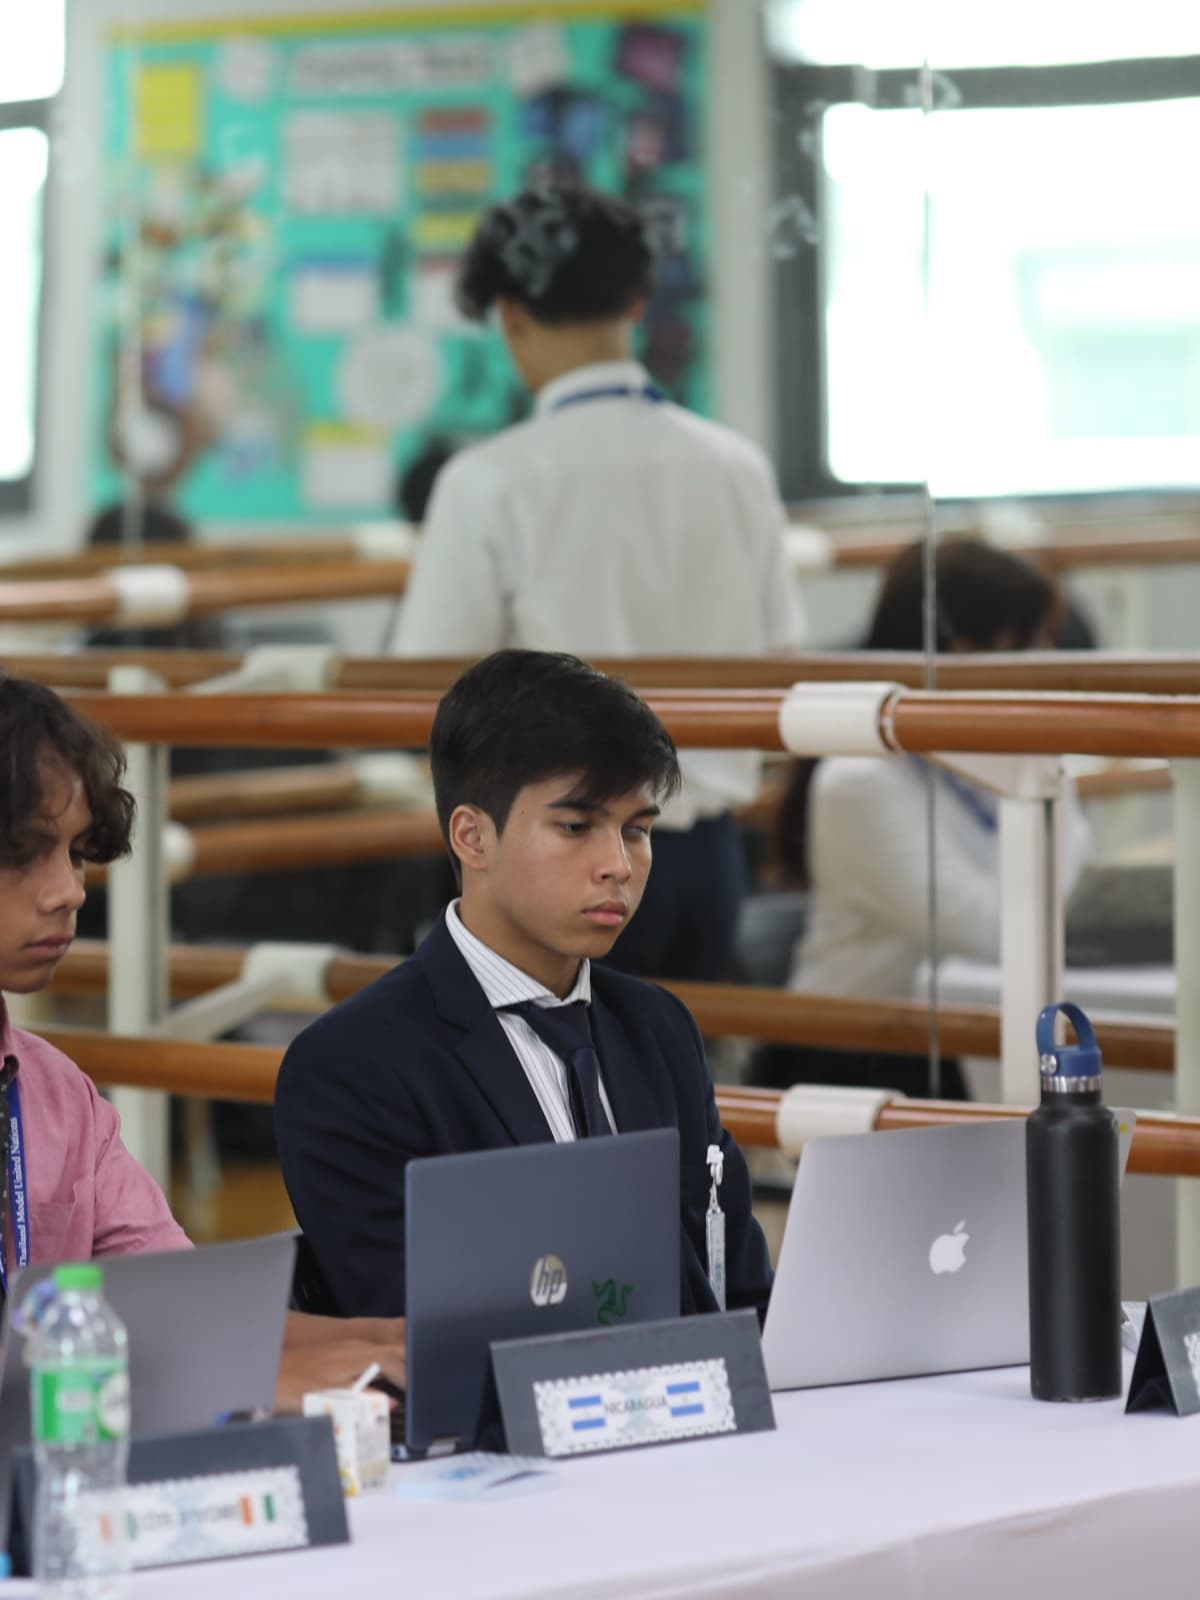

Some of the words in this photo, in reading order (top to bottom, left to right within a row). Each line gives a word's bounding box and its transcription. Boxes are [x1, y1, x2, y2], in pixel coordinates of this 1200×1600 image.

[10, 1117, 20, 1155] Nations
[11, 1156, 23, 1190] United
[15, 1191, 26, 1223] Model
[17, 1224, 27, 1267] Thailand
[535, 1256, 564, 1305] hp
[604, 1395, 668, 1416] NICARAGUA
